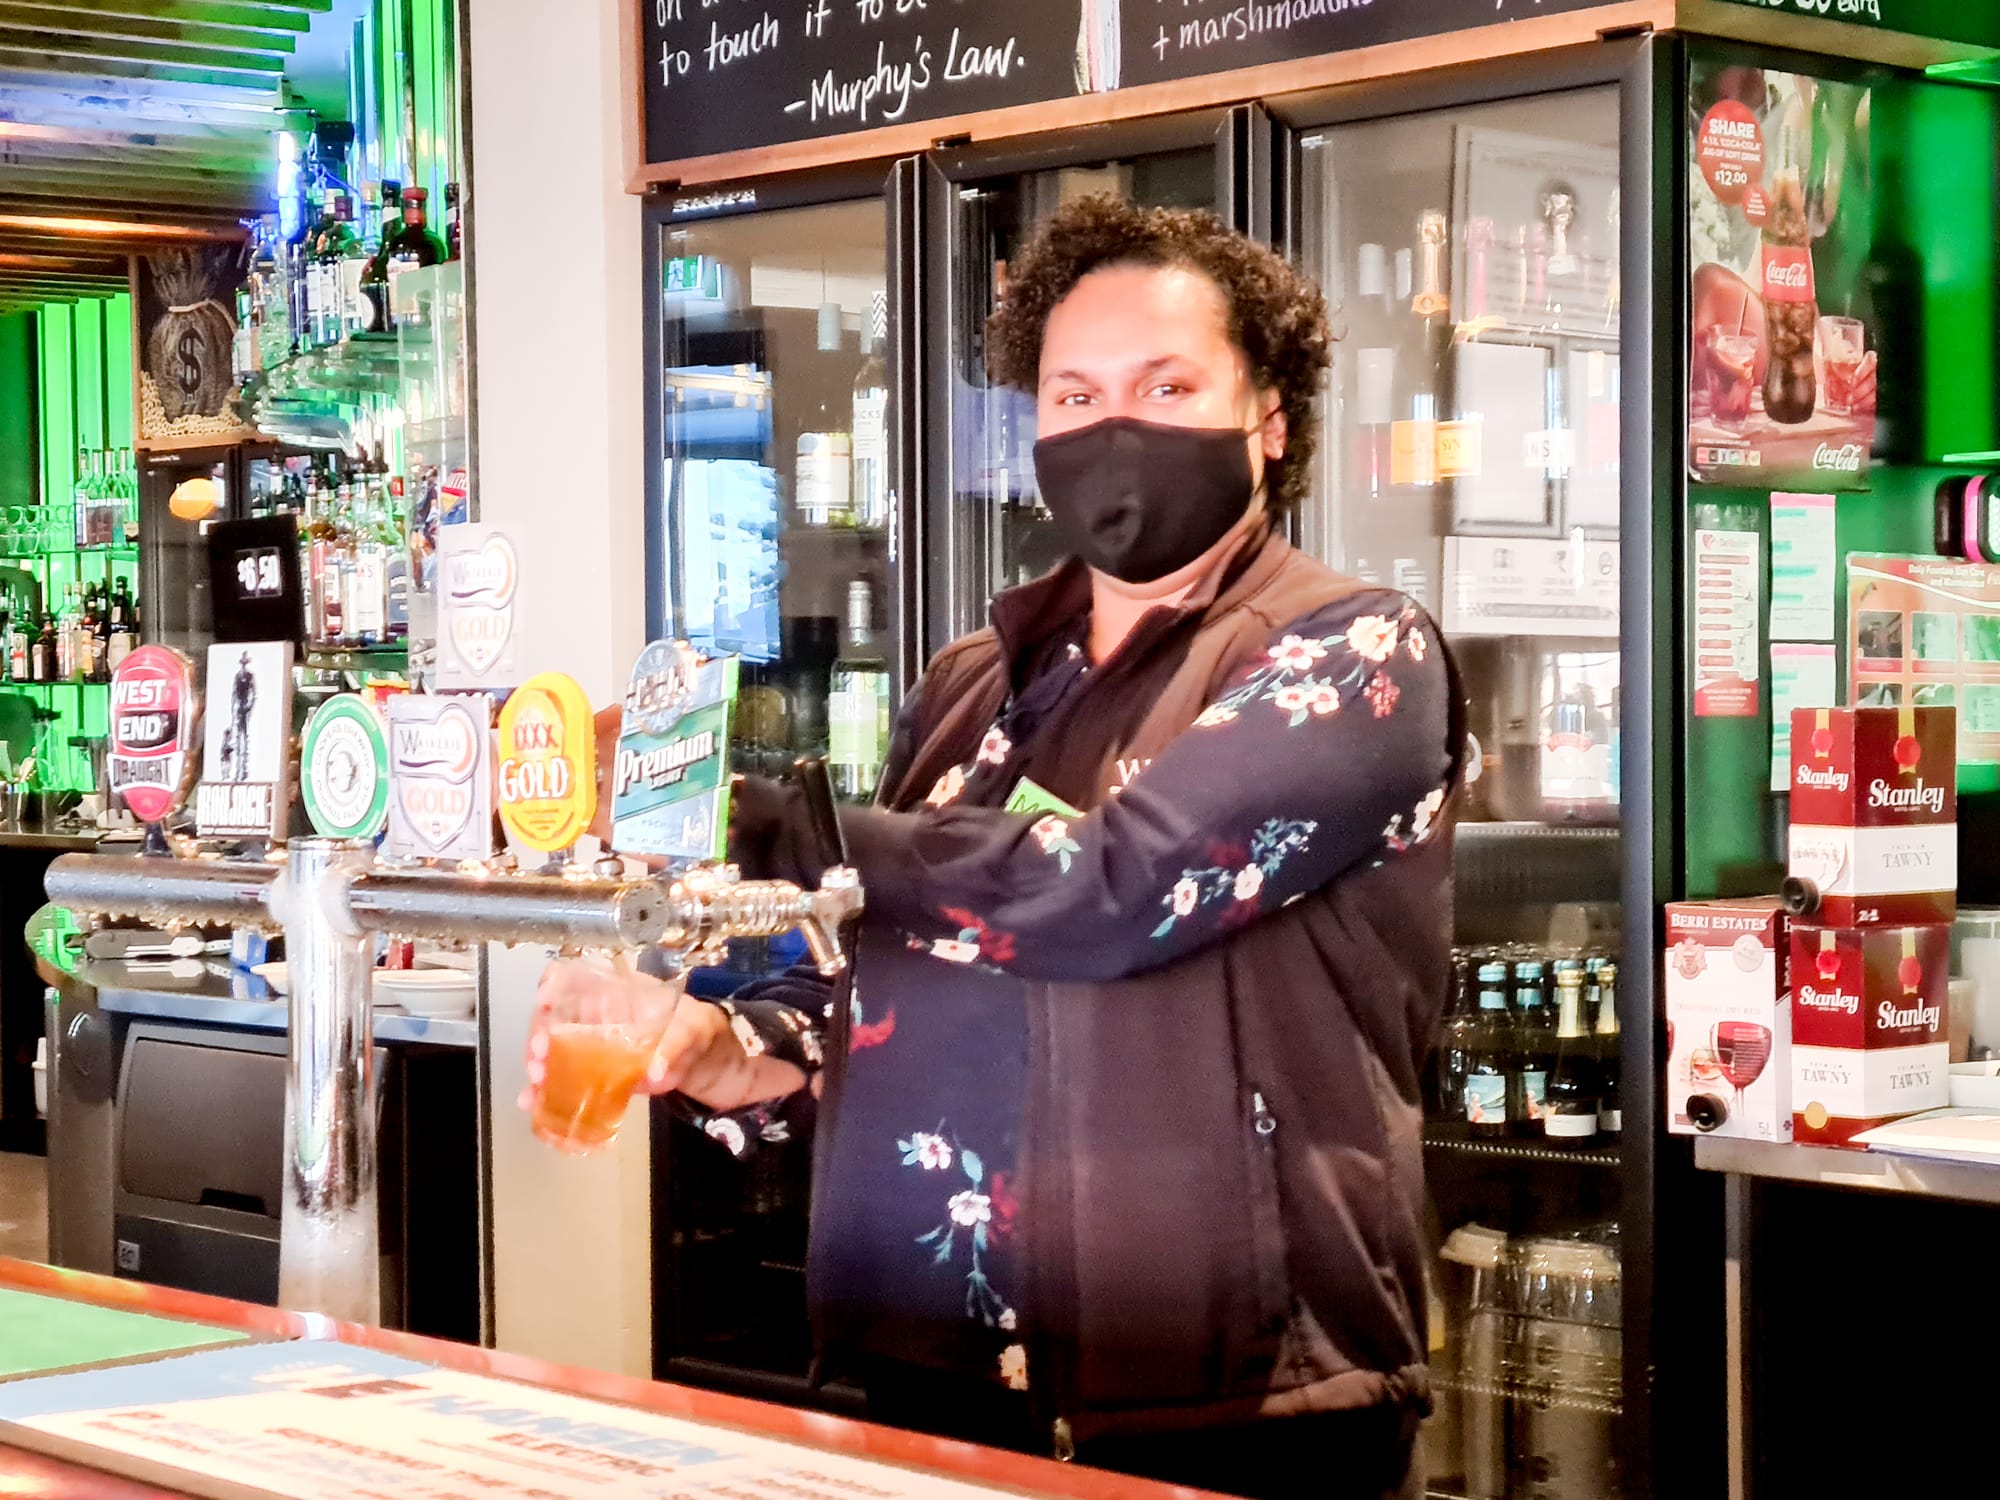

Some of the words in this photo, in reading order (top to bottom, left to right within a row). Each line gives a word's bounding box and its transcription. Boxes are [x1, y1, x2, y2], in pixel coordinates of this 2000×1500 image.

[659, 41, 690, 87] to
[704, 12, 779, 70] touch
[806, 0, 832, 37] it
[943, 27, 1025, 80] Law.
[1709, 118, 1755, 138] SHARE
[1715, 170, 1748, 186] $12.00
[111, 680, 167, 704] WEST
[118, 715, 163, 741] END
[112, 757, 174, 787] DRAUGHT
[616, 731, 715, 796] Premium
[499, 756, 568, 803] GOLD
[1796, 764, 1849, 792] Stanley
[406, 785, 466, 816] GOLD
[1868, 778, 1945, 813] Stanley
[1882, 851, 1934, 869] TAWNY
[1671, 913, 1709, 929] BERRI
[1712, 917, 1768, 931] ESTATES
[1800, 985, 1859, 1014] Stanley
[1877, 998, 1941, 1032] Stanley
[1801, 1068, 1852, 1085] TAWNY
[1889, 1070, 1934, 1090] TAWNY
